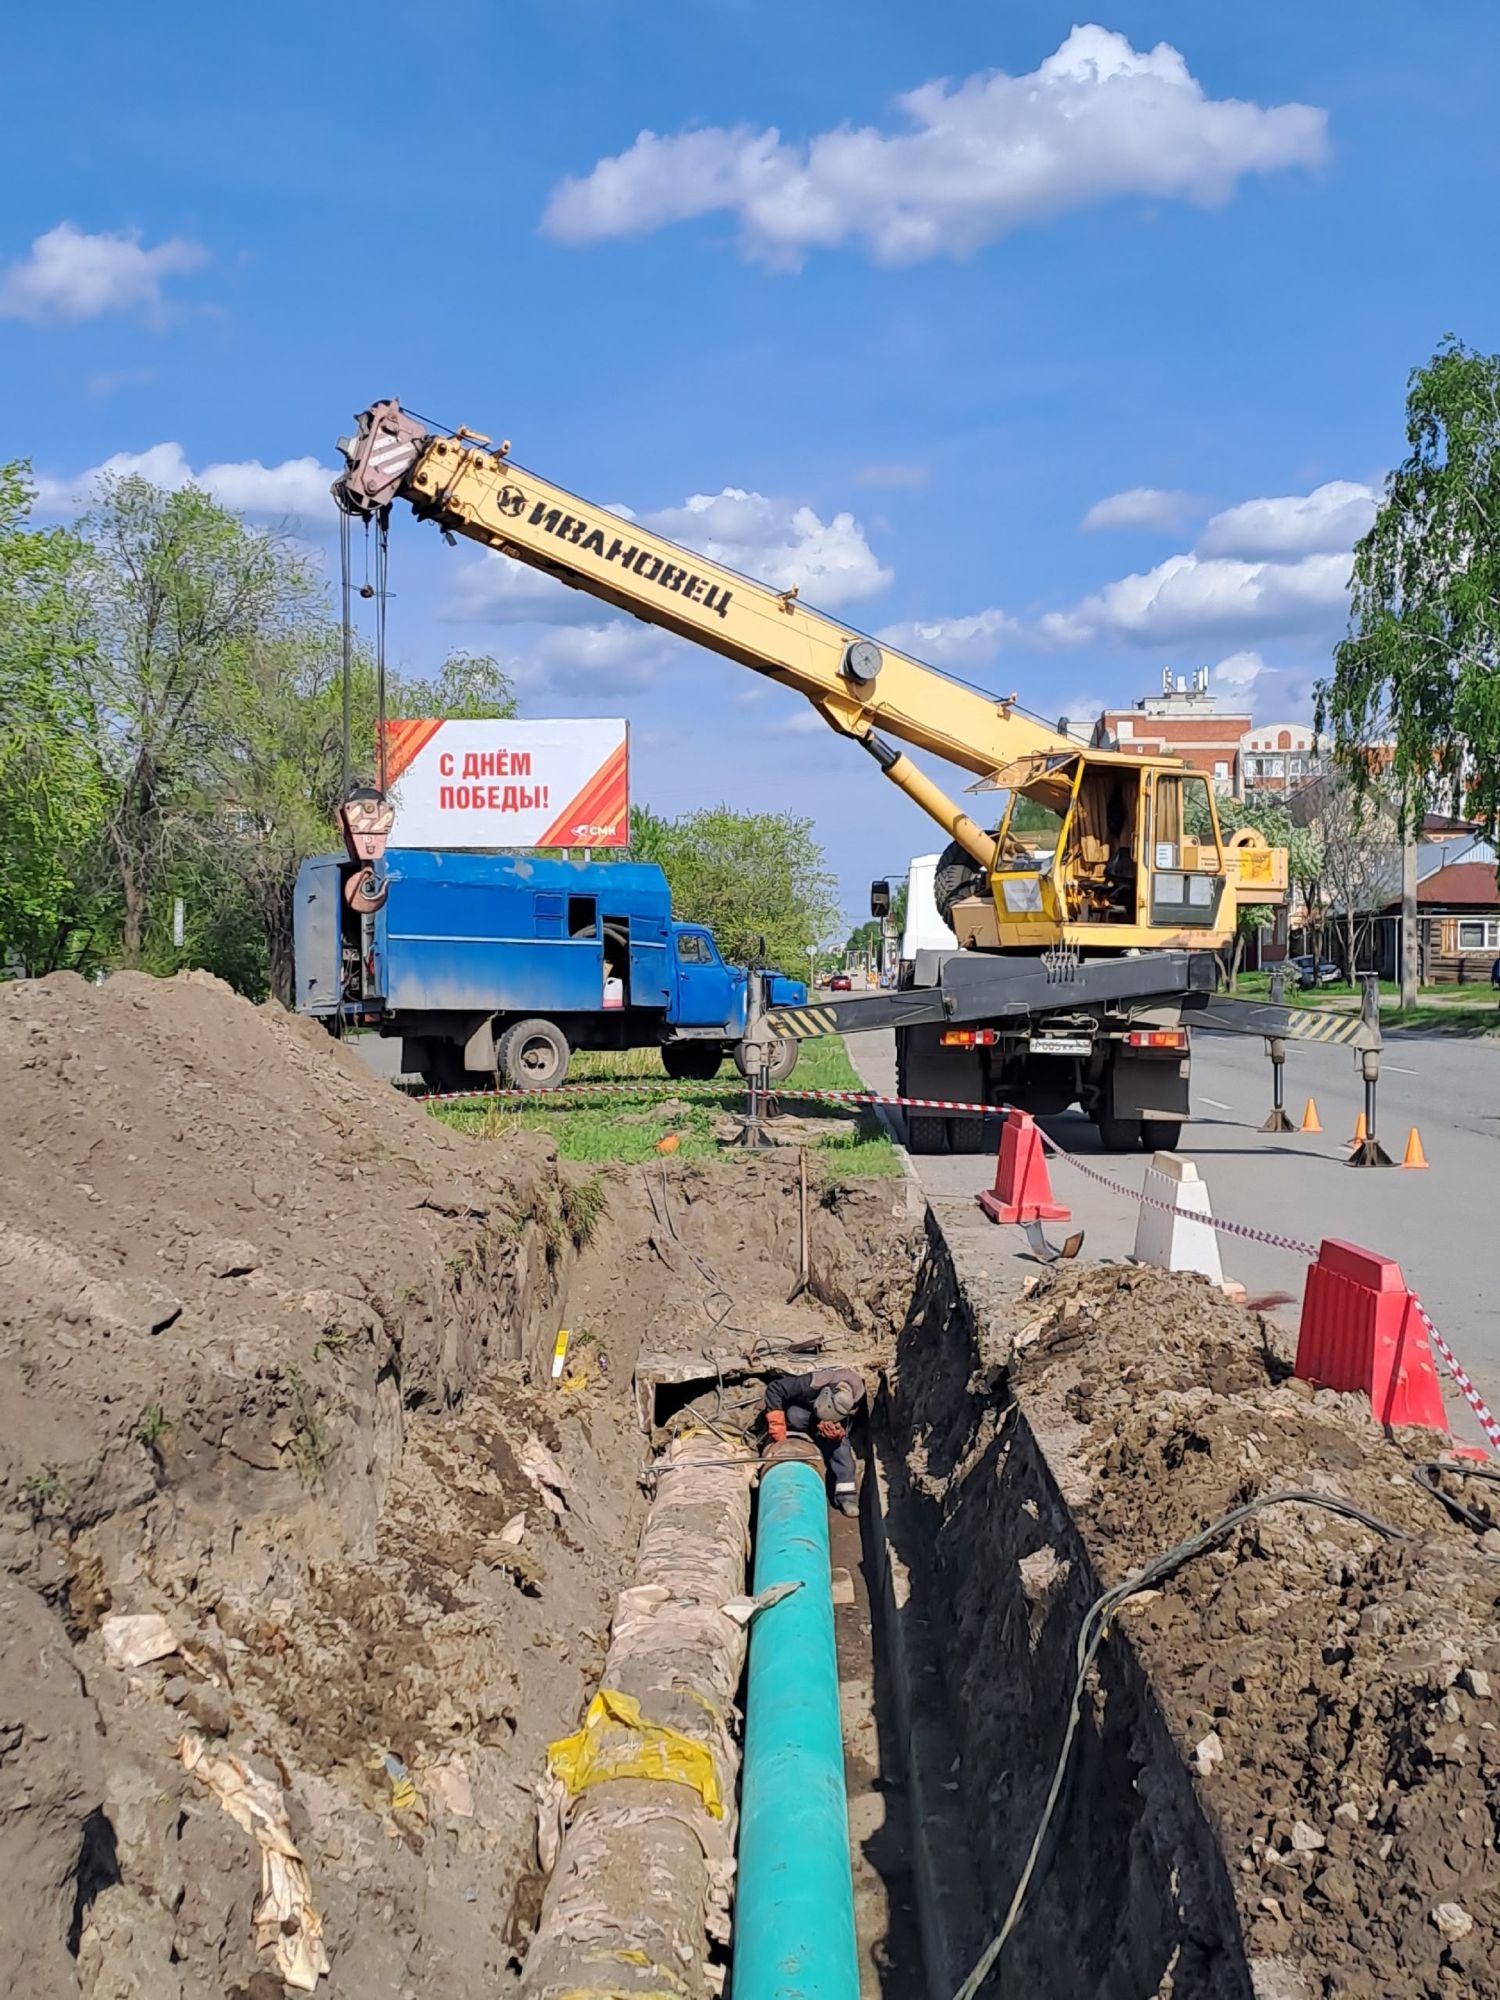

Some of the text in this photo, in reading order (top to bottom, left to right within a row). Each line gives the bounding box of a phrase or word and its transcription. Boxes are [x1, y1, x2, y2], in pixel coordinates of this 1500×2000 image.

[528, 502, 733, 618] ИВАНОВЕЦ
[440, 749, 531, 780] С ДНЁМ
[440, 785, 549, 811] ПОБЕДЫ!
